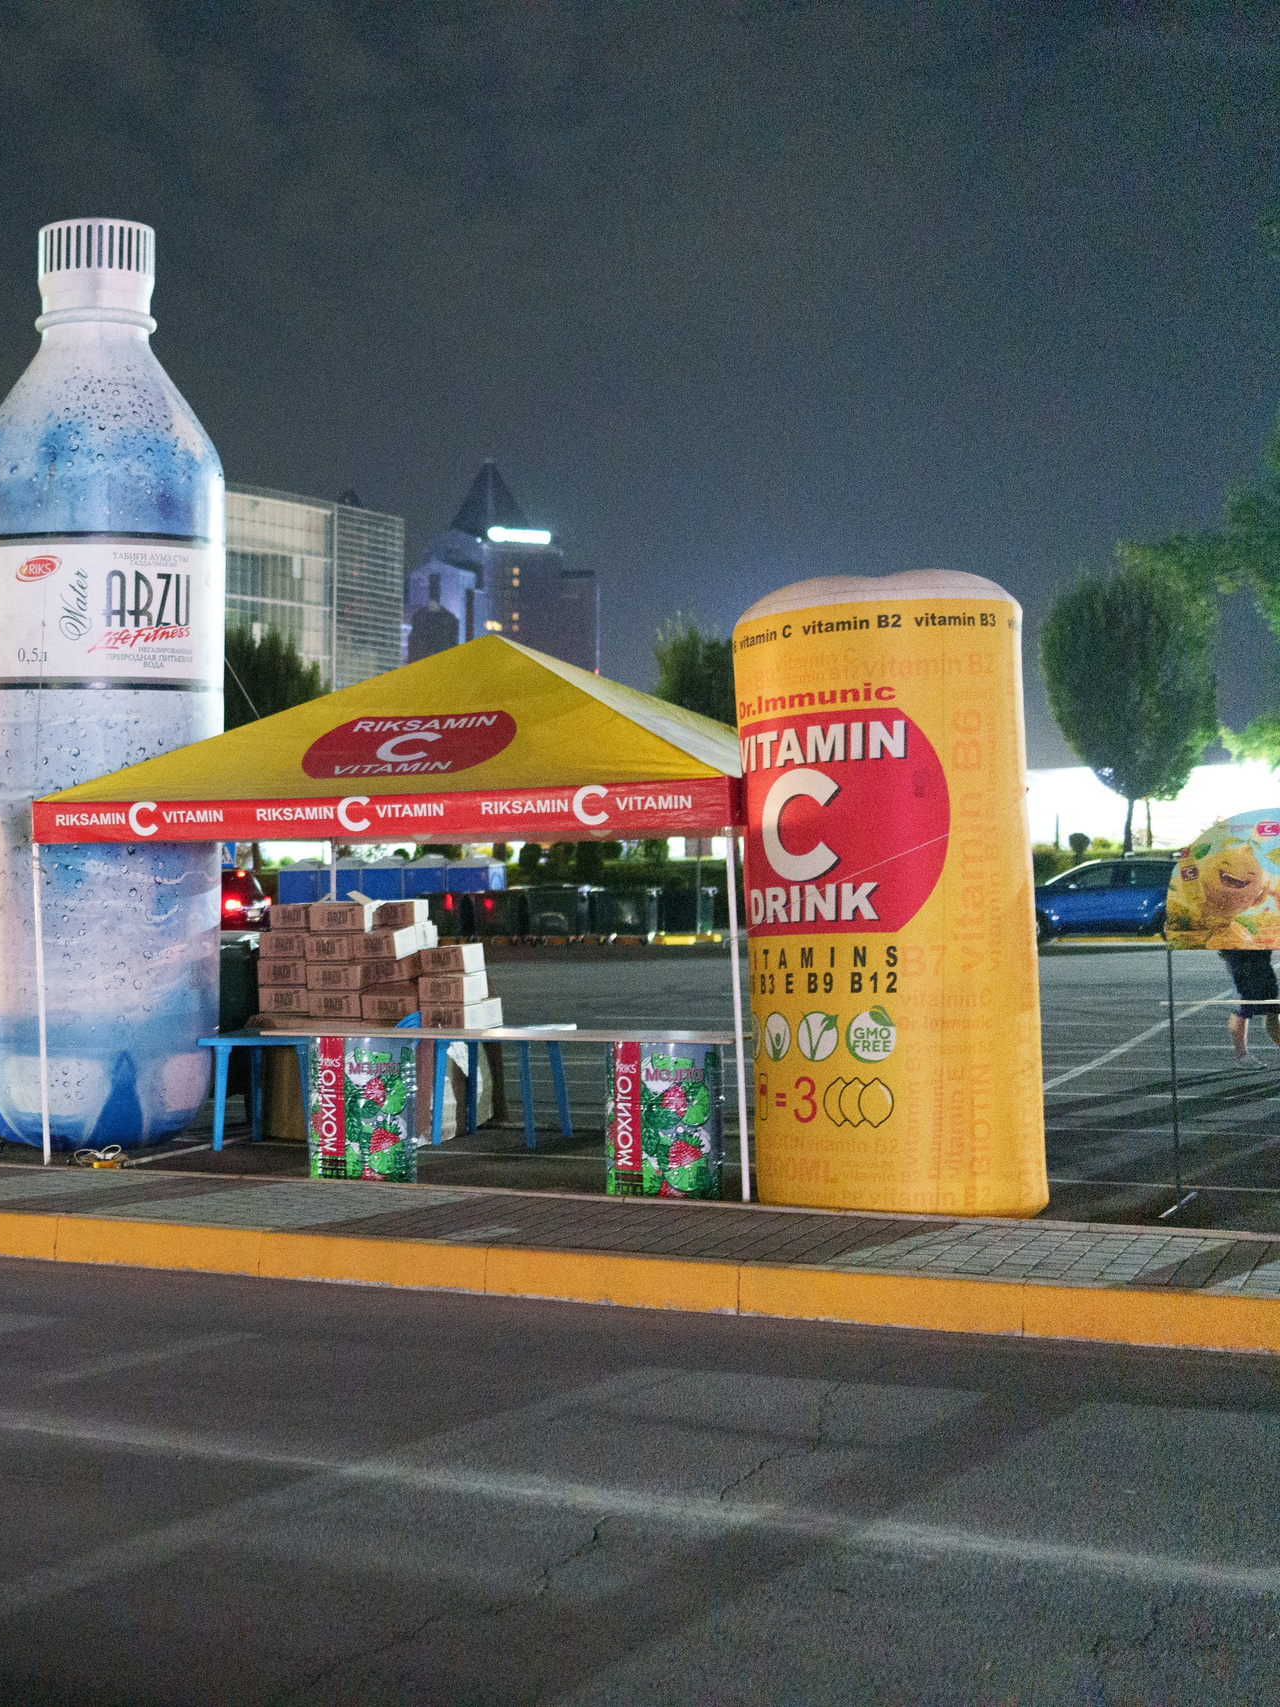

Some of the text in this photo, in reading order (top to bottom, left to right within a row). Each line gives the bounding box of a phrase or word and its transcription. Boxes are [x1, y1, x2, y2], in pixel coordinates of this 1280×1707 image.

[29, 563, 51, 574] RIKS
[59, 568, 92, 641] Water
[102, 570, 191, 628] ARZU
[740, 629, 777, 650] vitamin
[782, 624, 792, 639] C
[802, 615, 870, 636] vitamin
[876, 614, 902, 629] B2
[914, 612, 975, 627] vitamin
[980, 613, 996, 627] B3
[17, 648, 48, 664] 0,5л
[106, 653, 157, 662] ПРИРОДНАЯ
[143, 661, 164, 669] ВОДА
[739, 682, 896, 719] Dr.Immunic
[353, 715, 498, 732] RIKSAMIN
[376, 731, 443, 762] C
[740, 720, 907, 773] VITAMIN
[333, 760, 453, 776] VITAMIN
[55, 784, 692, 836] RIKSAMIN C VITAMIN RIKSAMIN C VITAMIN RIKSAMIN C VITAMIN
[762, 768, 842, 882] C
[750, 883, 881, 925] DRINK
[752, 945, 898, 969] ITAMINS
[760, 972, 775, 995] B3
[785, 973, 794, 994] E
[807, 971, 833, 994] B9
[850, 971, 898, 993] B12
[853, 1027, 891, 1040] GMO
[853, 1040, 892, 1053] FREE
[349, 1062, 400, 1076] MOJITO
[619, 1062, 637, 1074] RIKS
[645, 1068, 703, 1082] MOJITO
[321, 1069, 337, 1152] МОХИТО
[616, 1075, 633, 1166] МОХИТО
